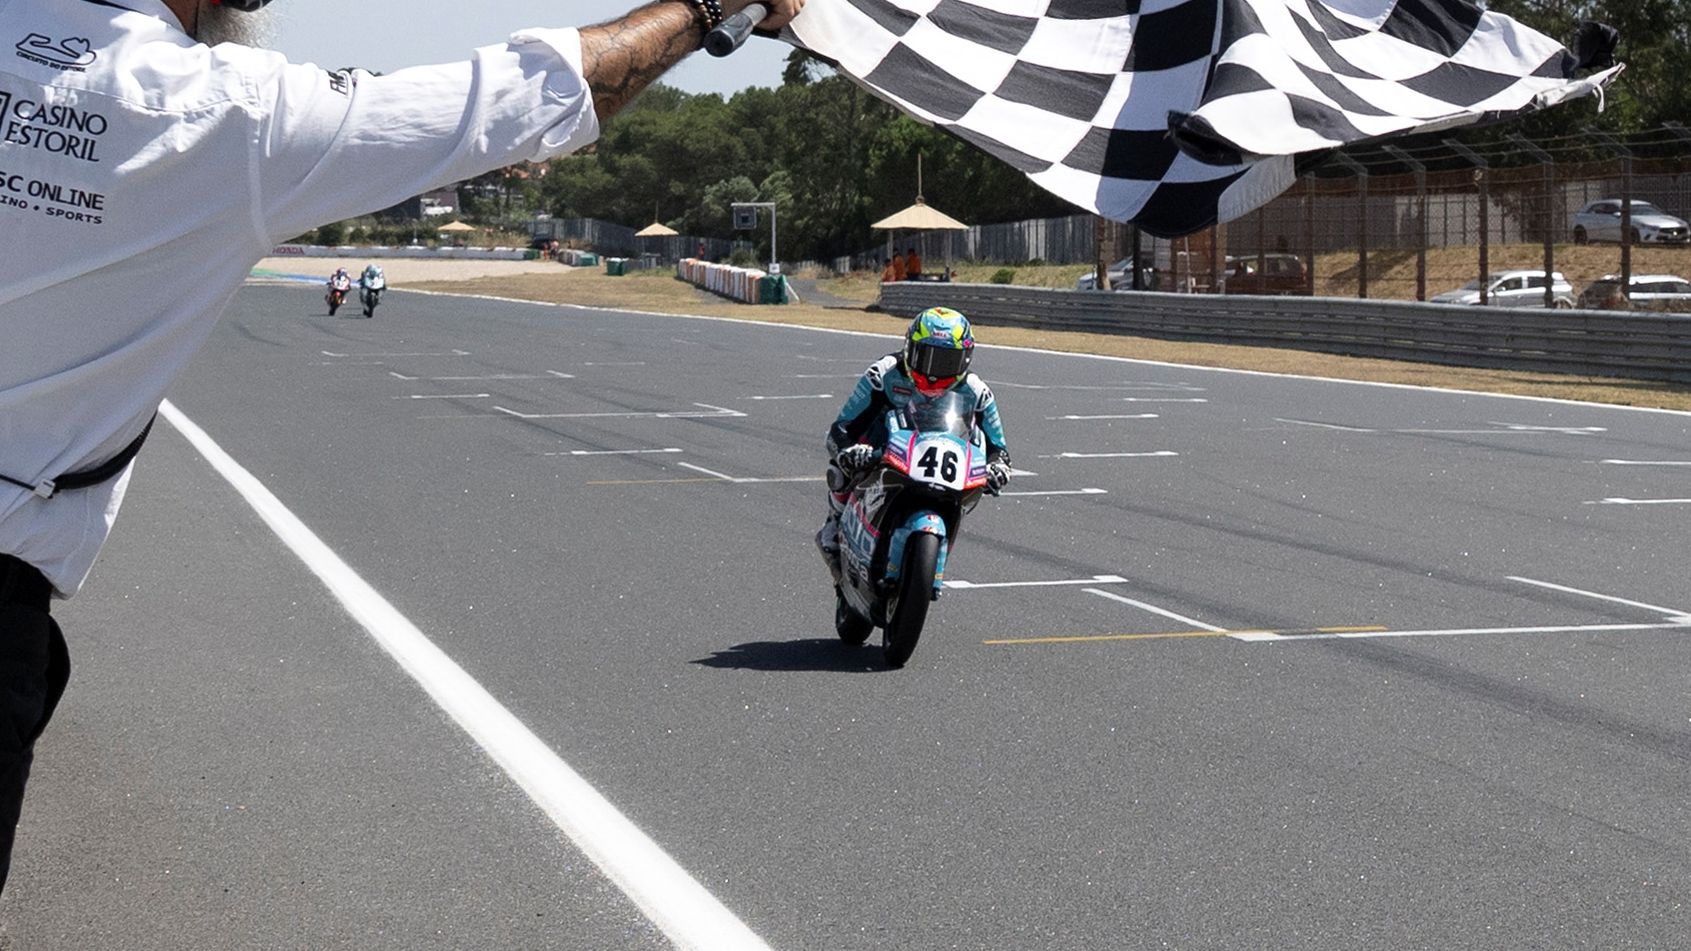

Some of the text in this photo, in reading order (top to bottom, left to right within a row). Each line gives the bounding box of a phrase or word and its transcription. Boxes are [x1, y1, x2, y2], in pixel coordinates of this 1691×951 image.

[16, 51, 49, 66] CIRCUITO
[49, 62, 61, 70] DO
[13, 100, 107, 135] CASINO
[4, 121, 100, 162] ESTORIL
[27, 180, 105, 210] ONLINE
[45, 207, 103, 224] SPORTS
[271, 246, 305, 255] HONDA
[916, 446, 958, 483] 46
